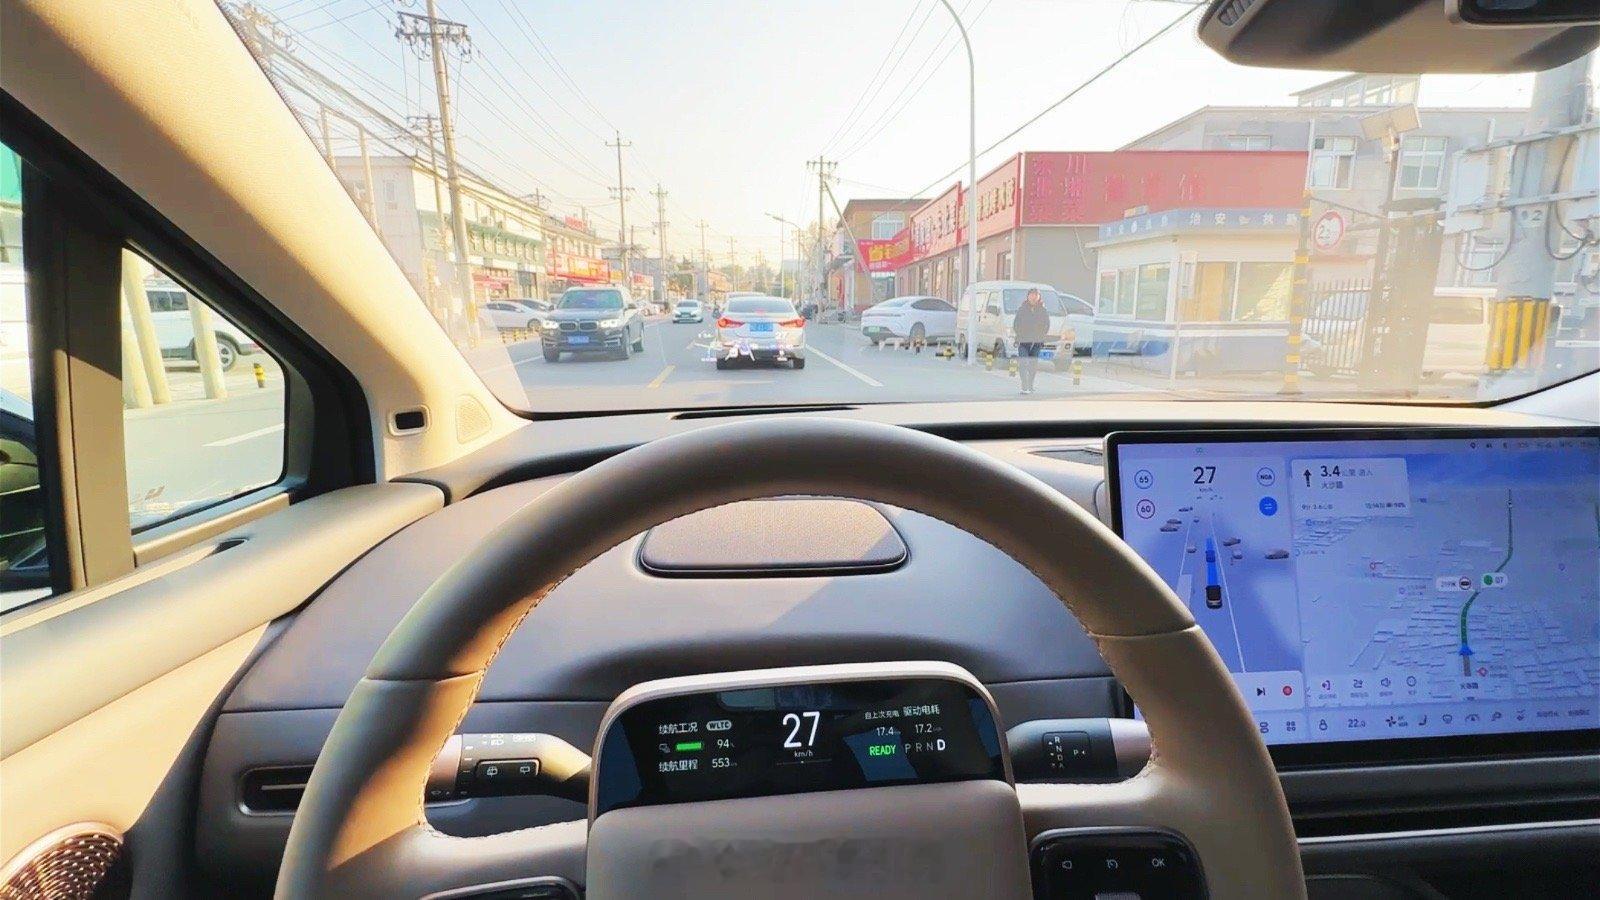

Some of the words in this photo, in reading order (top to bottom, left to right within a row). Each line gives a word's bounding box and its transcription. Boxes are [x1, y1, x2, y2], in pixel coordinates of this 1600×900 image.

[1193, 466, 1216, 484] 27
[1320, 465, 1341, 477] 3.4
[1139, 475, 1149, 483] 65
[1140, 505, 1151, 513] 60
[864, 710, 900, 720] 自上次充电
[903, 704, 940, 717] 驱动电耗
[658, 722, 698, 735] 续航工况
[709, 722, 731, 730] WLTC
[915, 723, 933, 733] 17.2
[1347, 718, 1366, 728] 22.0
[781, 711, 821, 748] 27
[876, 726, 894, 736] 17.4
[869, 744, 896, 756] READY
[937, 739, 946, 751] D
[794, 750, 814, 758] km/h
[658, 759, 698, 773] 续航里程
[1151, 858, 1166, 866] OK
